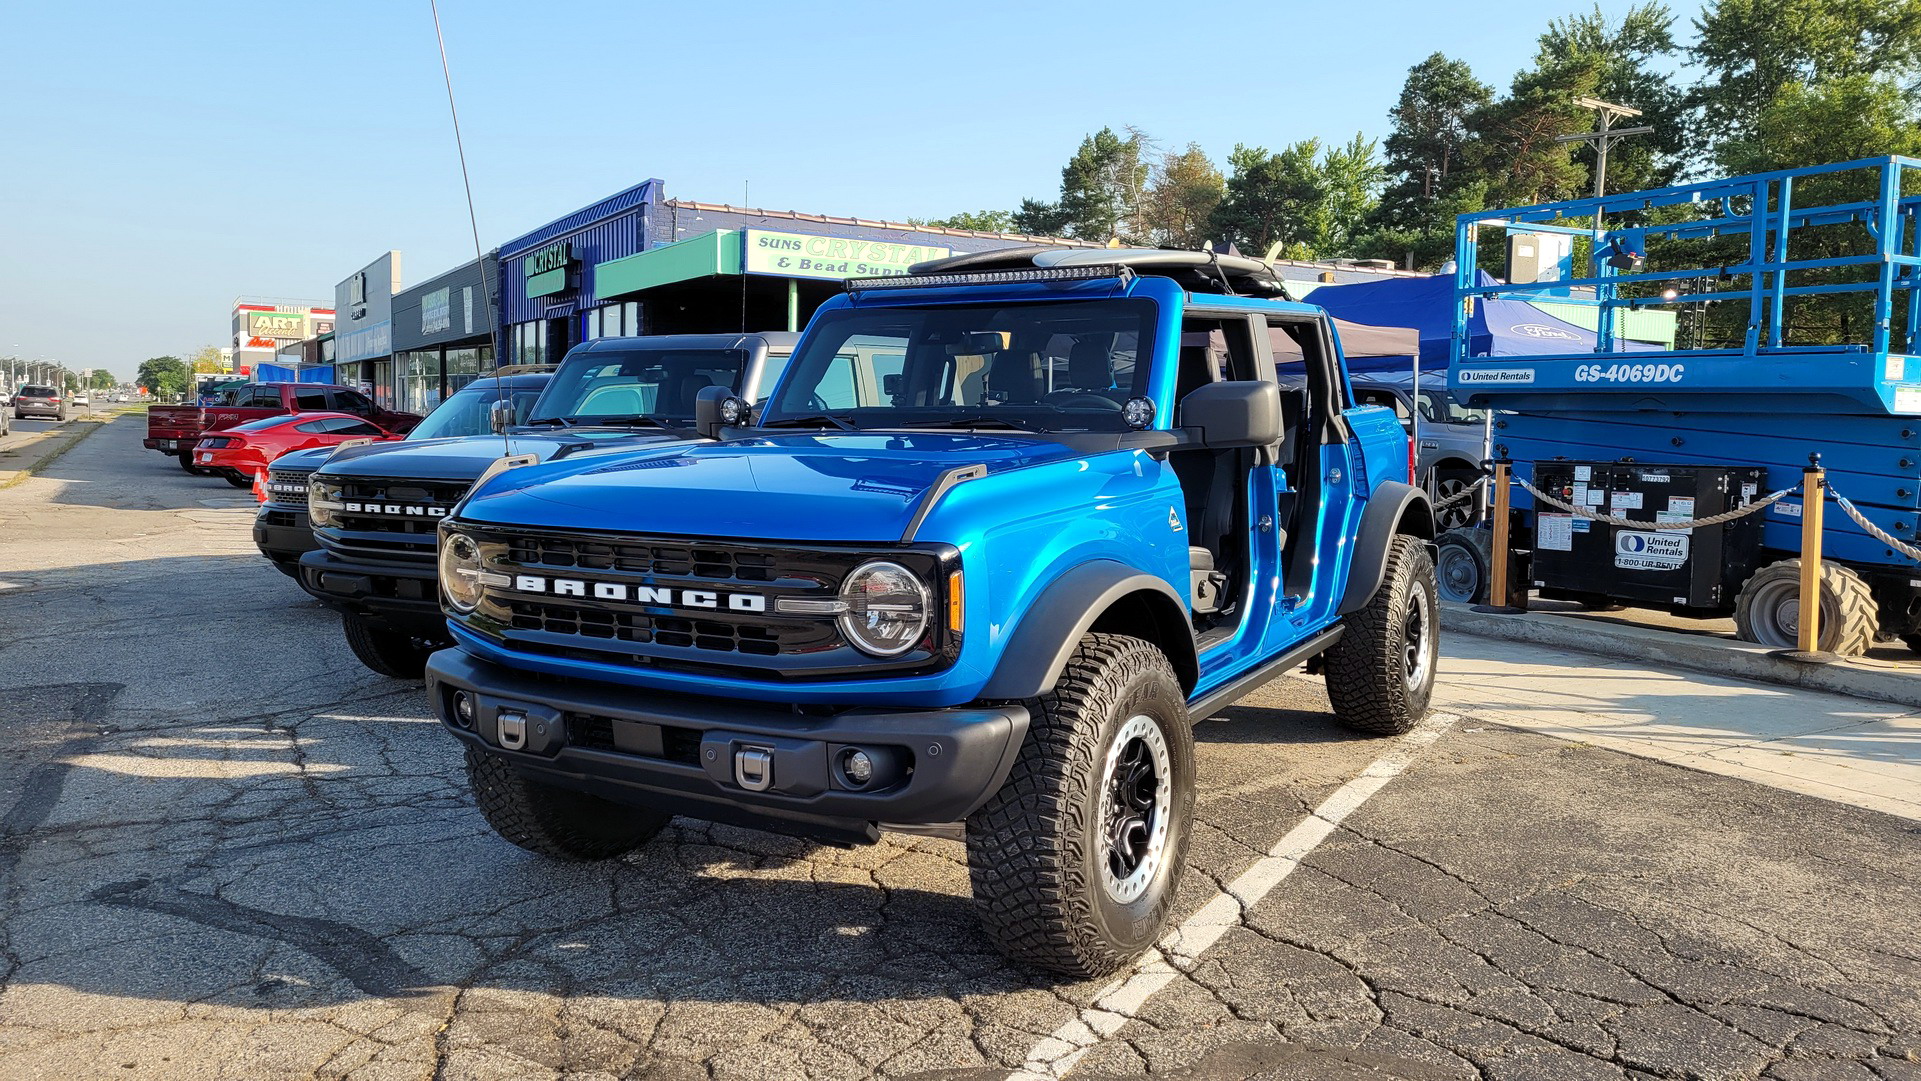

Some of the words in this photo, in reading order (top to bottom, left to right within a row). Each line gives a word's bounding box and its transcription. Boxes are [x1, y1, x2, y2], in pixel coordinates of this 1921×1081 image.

[758, 237, 802, 250] SUNS
[805, 236, 938, 264] CRYSTAL
[534, 243, 568, 274] CRYSTAL
[777, 256, 791, 268] &
[799, 259, 849, 273] Bead
[254, 316, 301, 329] ART
[1472, 372, 1499, 381] United
[1499, 371, 1531, 381] Rentals
[1574, 364, 1685, 383] GS-4069DC
[273, 484, 309, 493] BRO
[346, 502, 454, 517] BRONC
[1647, 537, 1681, 547] United
[1646, 546, 1684, 556] Rentals
[516, 575, 766, 612] BRONCO
